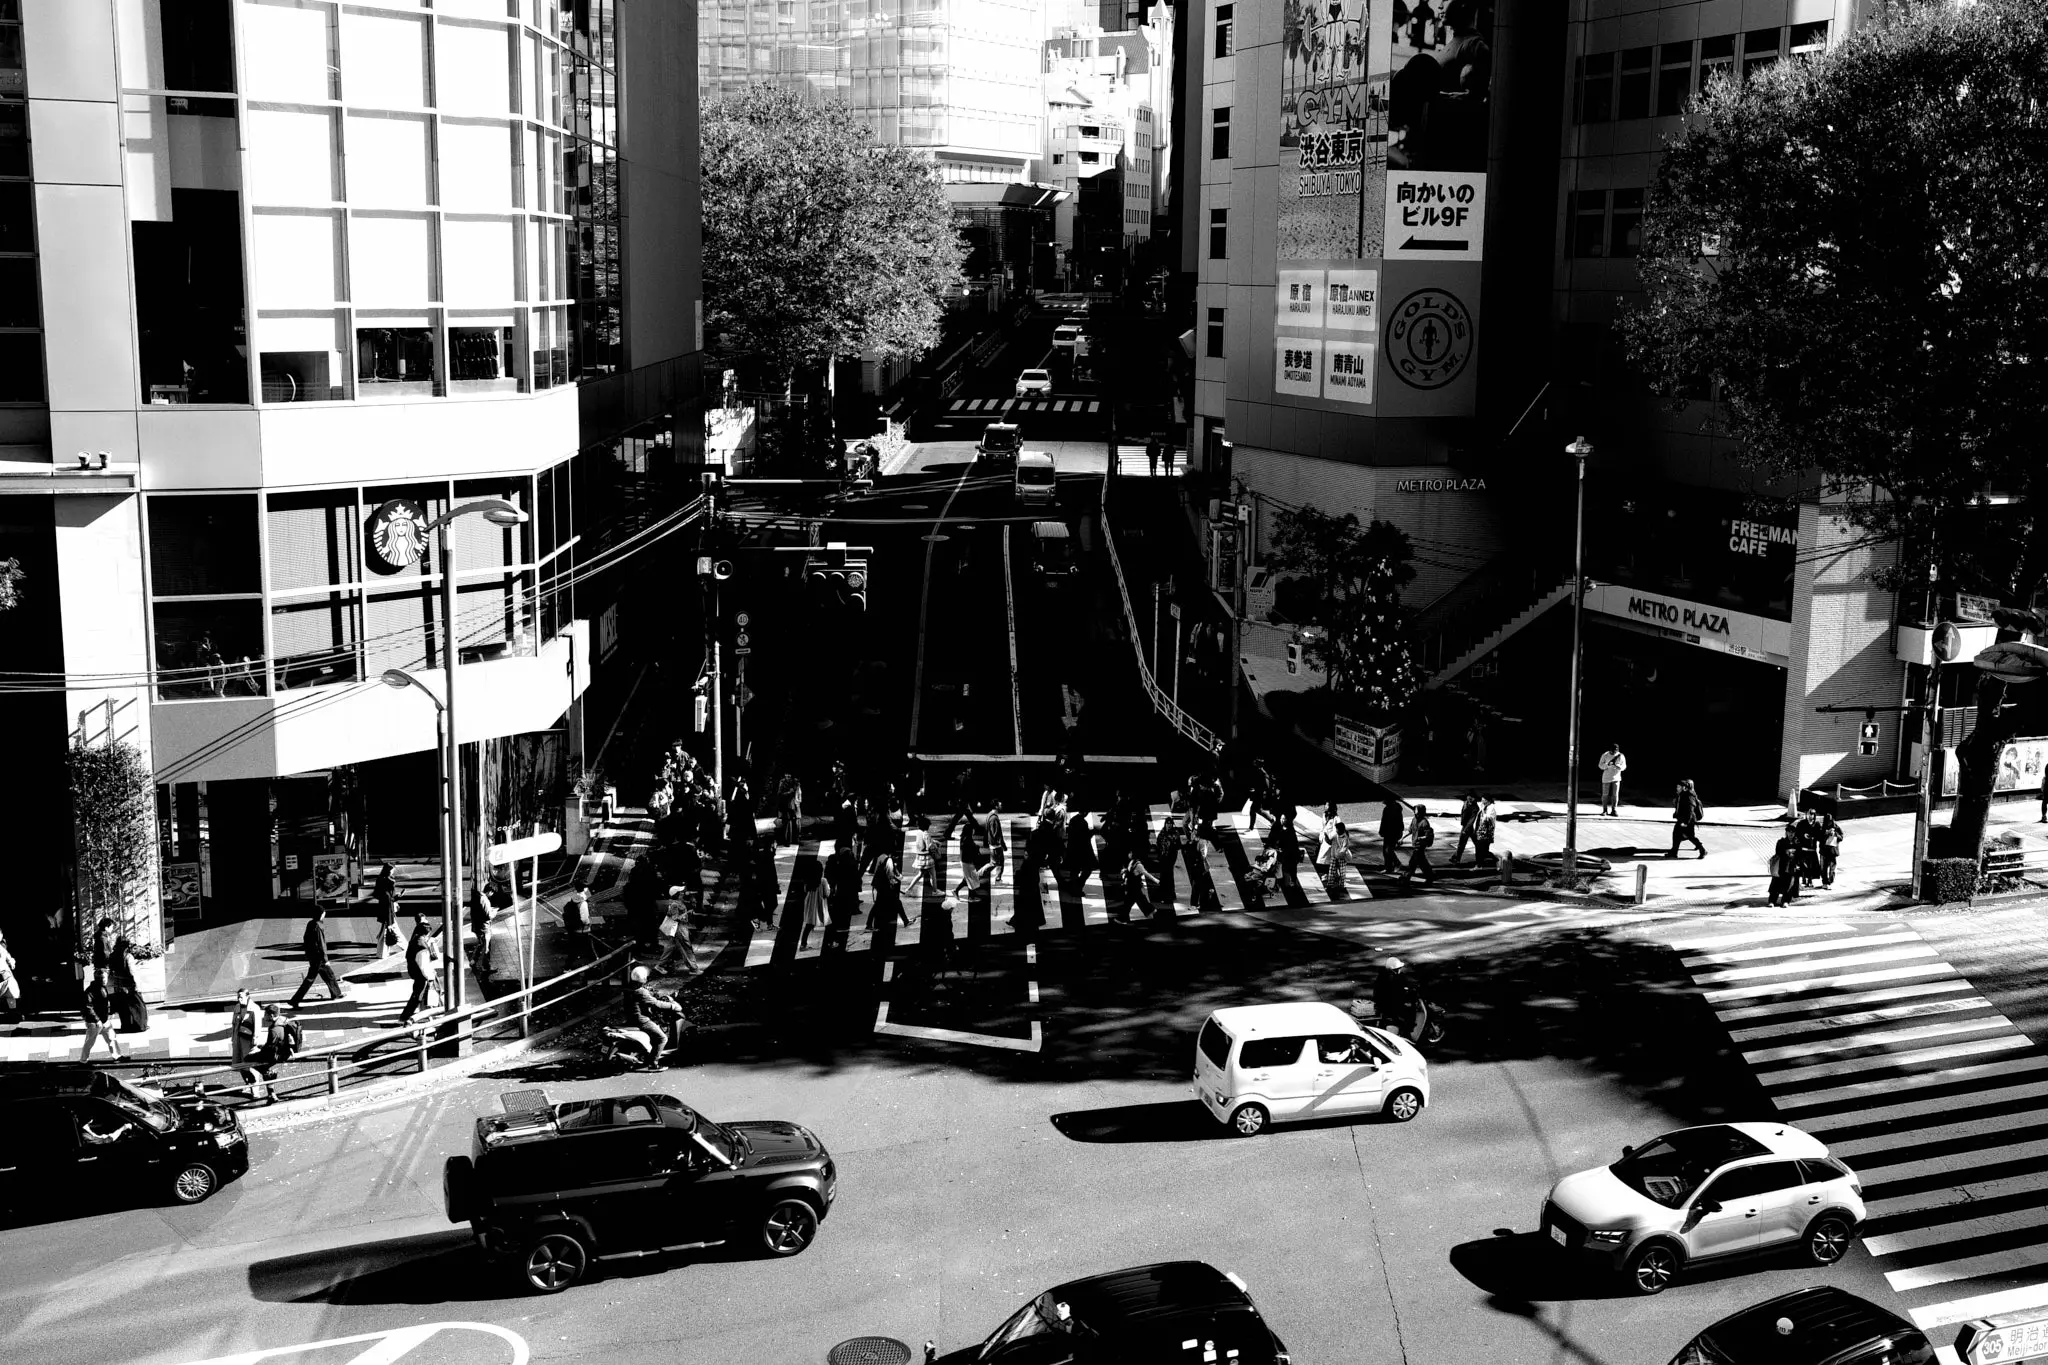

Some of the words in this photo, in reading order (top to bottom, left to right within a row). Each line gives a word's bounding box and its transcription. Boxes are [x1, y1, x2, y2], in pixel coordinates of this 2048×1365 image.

[1297, 84, 1370, 127] GYM
[1298, 129, 1364, 168] 渋谷東京
[1298, 172, 1332, 197] SHIBUYA
[1335, 170, 1362, 194] TOKYO
[1396, 182, 1475, 204] 向かいの
[1402, 206, 1469, 227] ビル9F
[1394, 297, 1467, 340] GOLD'S
[1284, 349, 1313, 370] 表参道
[1333, 353, 1364, 375] 南青山
[1397, 479, 1443, 492] METRO
[1446, 478, 1487, 491] PLAZA
[1729, 536, 1767, 557] CAFE
[1629, 596, 1679, 623] METRO
[1683, 607, 1730, 636] PLAZA
[1984, 1340, 2002, 1355] 305
